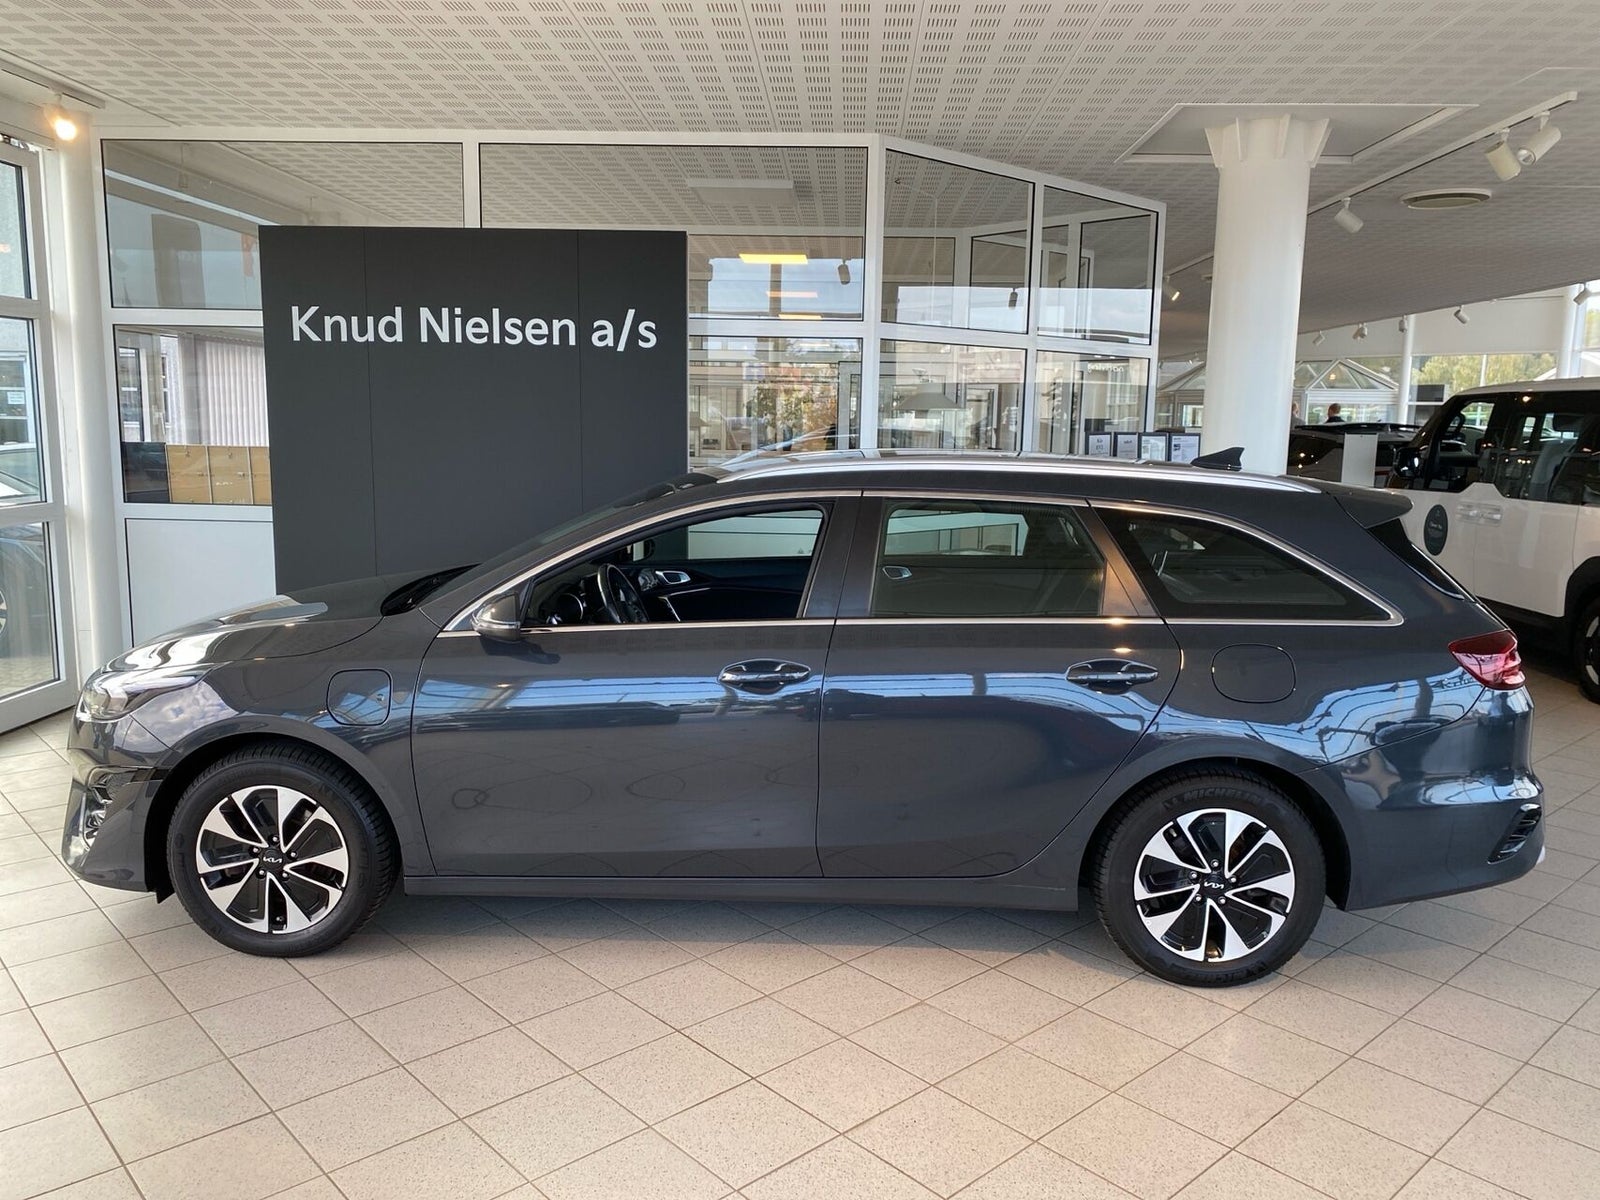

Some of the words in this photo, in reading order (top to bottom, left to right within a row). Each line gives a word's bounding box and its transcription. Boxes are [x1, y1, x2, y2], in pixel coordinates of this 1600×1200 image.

[291, 305, 403, 342] Knud
[419, 307, 576, 346] Nielsen
[591, 309, 657, 352] a/s
